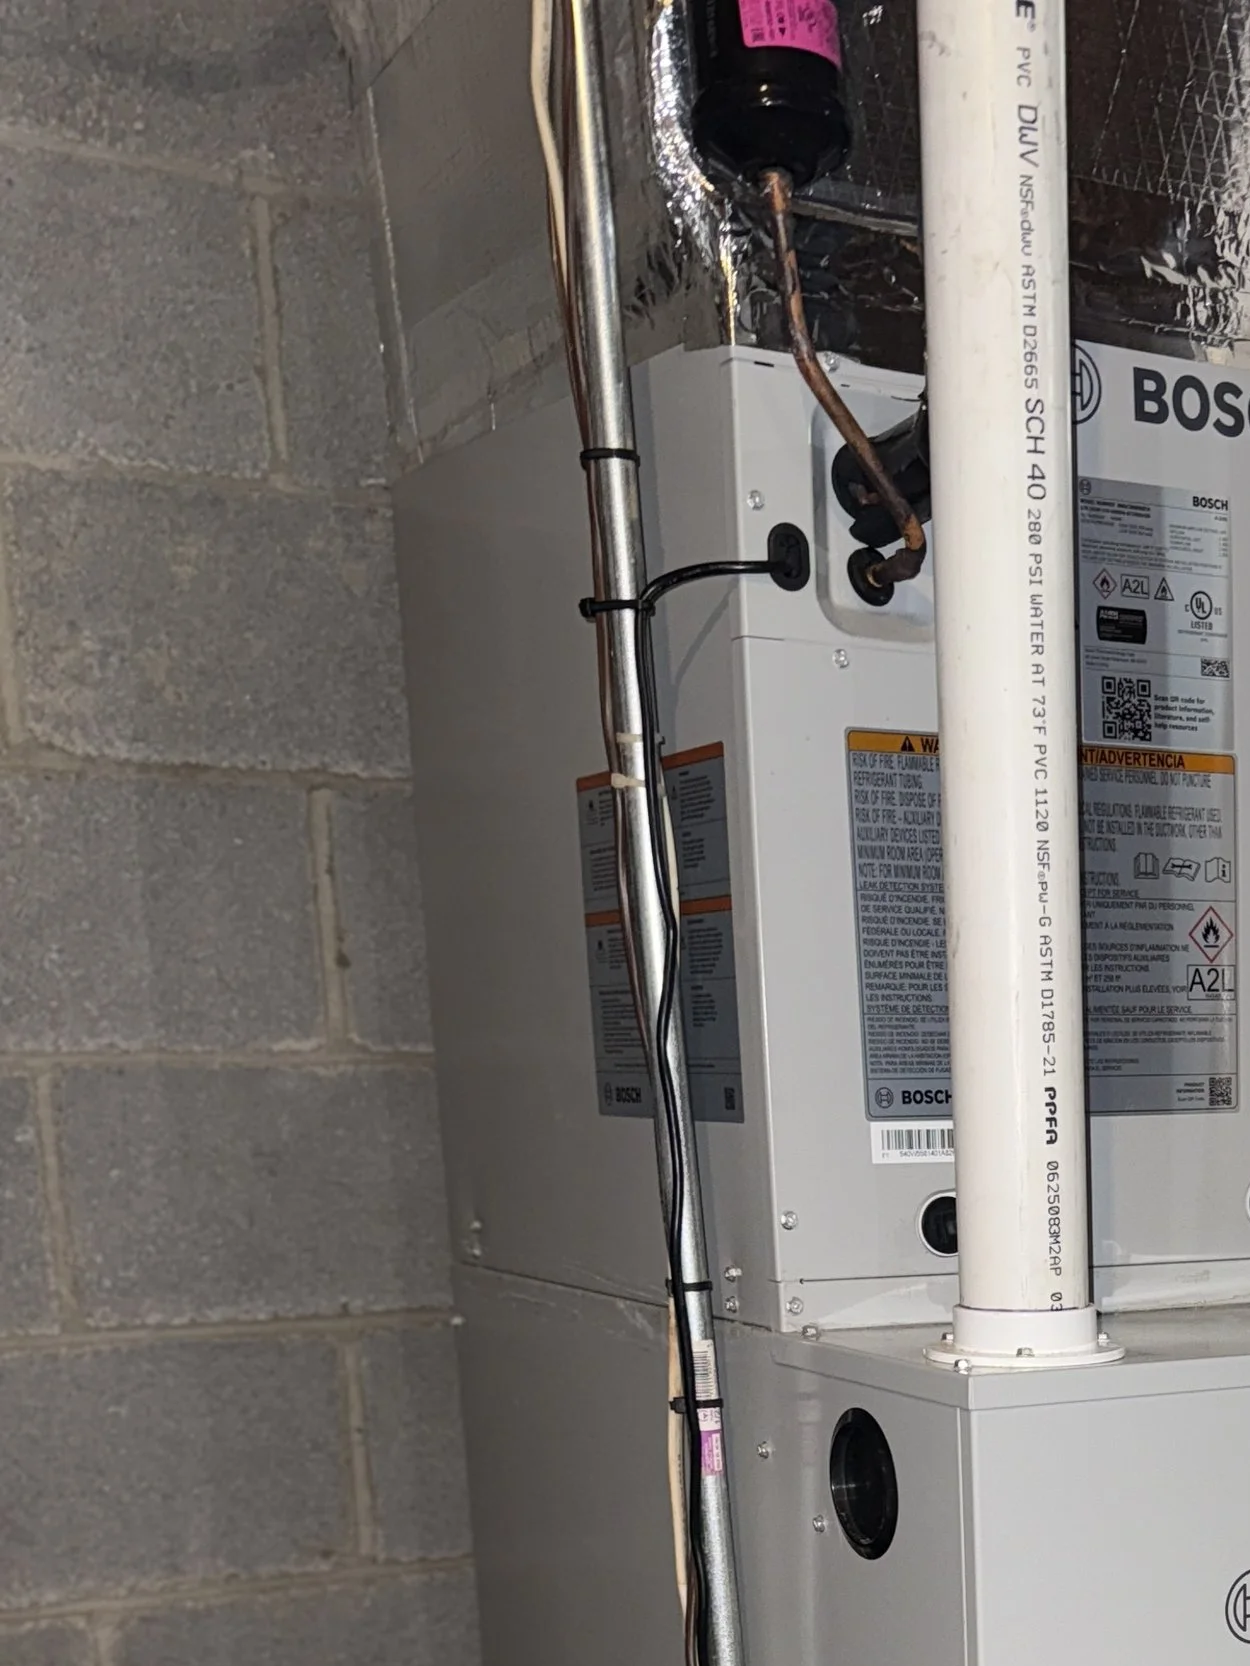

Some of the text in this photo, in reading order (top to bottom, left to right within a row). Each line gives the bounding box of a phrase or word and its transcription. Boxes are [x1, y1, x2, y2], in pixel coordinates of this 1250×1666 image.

[1015, 46, 1032, 88] PVC
[1016, 104, 1039, 168] DWV
[1021, 264, 1037, 317] ASTM
[1022, 325, 1039, 390] D2665
[1024, 397, 1046, 455] SCH
[1026, 463, 1047, 501] 40
[1192, 496, 1229, 511] BOSCH
[1026, 508, 1043, 546] 280
[1028, 552, 1044, 586] PSI
[1122, 578, 1148, 595] A2L
[1029, 593, 1045, 656] WATER
[1191, 621, 1213, 630] LISTED
[1030, 663, 1045, 687] AT
[1032, 694, 1048, 735] 73°F
[1033, 743, 1048, 781] PVC
[1034, 787, 1049, 833] 1120
[879, 882, 919, 891] DETECTION
[1039, 934, 1054, 982] ASTM
[1189, 967, 1235, 993] A2L
[1040, 988, 1057, 1077] D1785-21
[1043, 1086, 1059, 1145] PPFA
